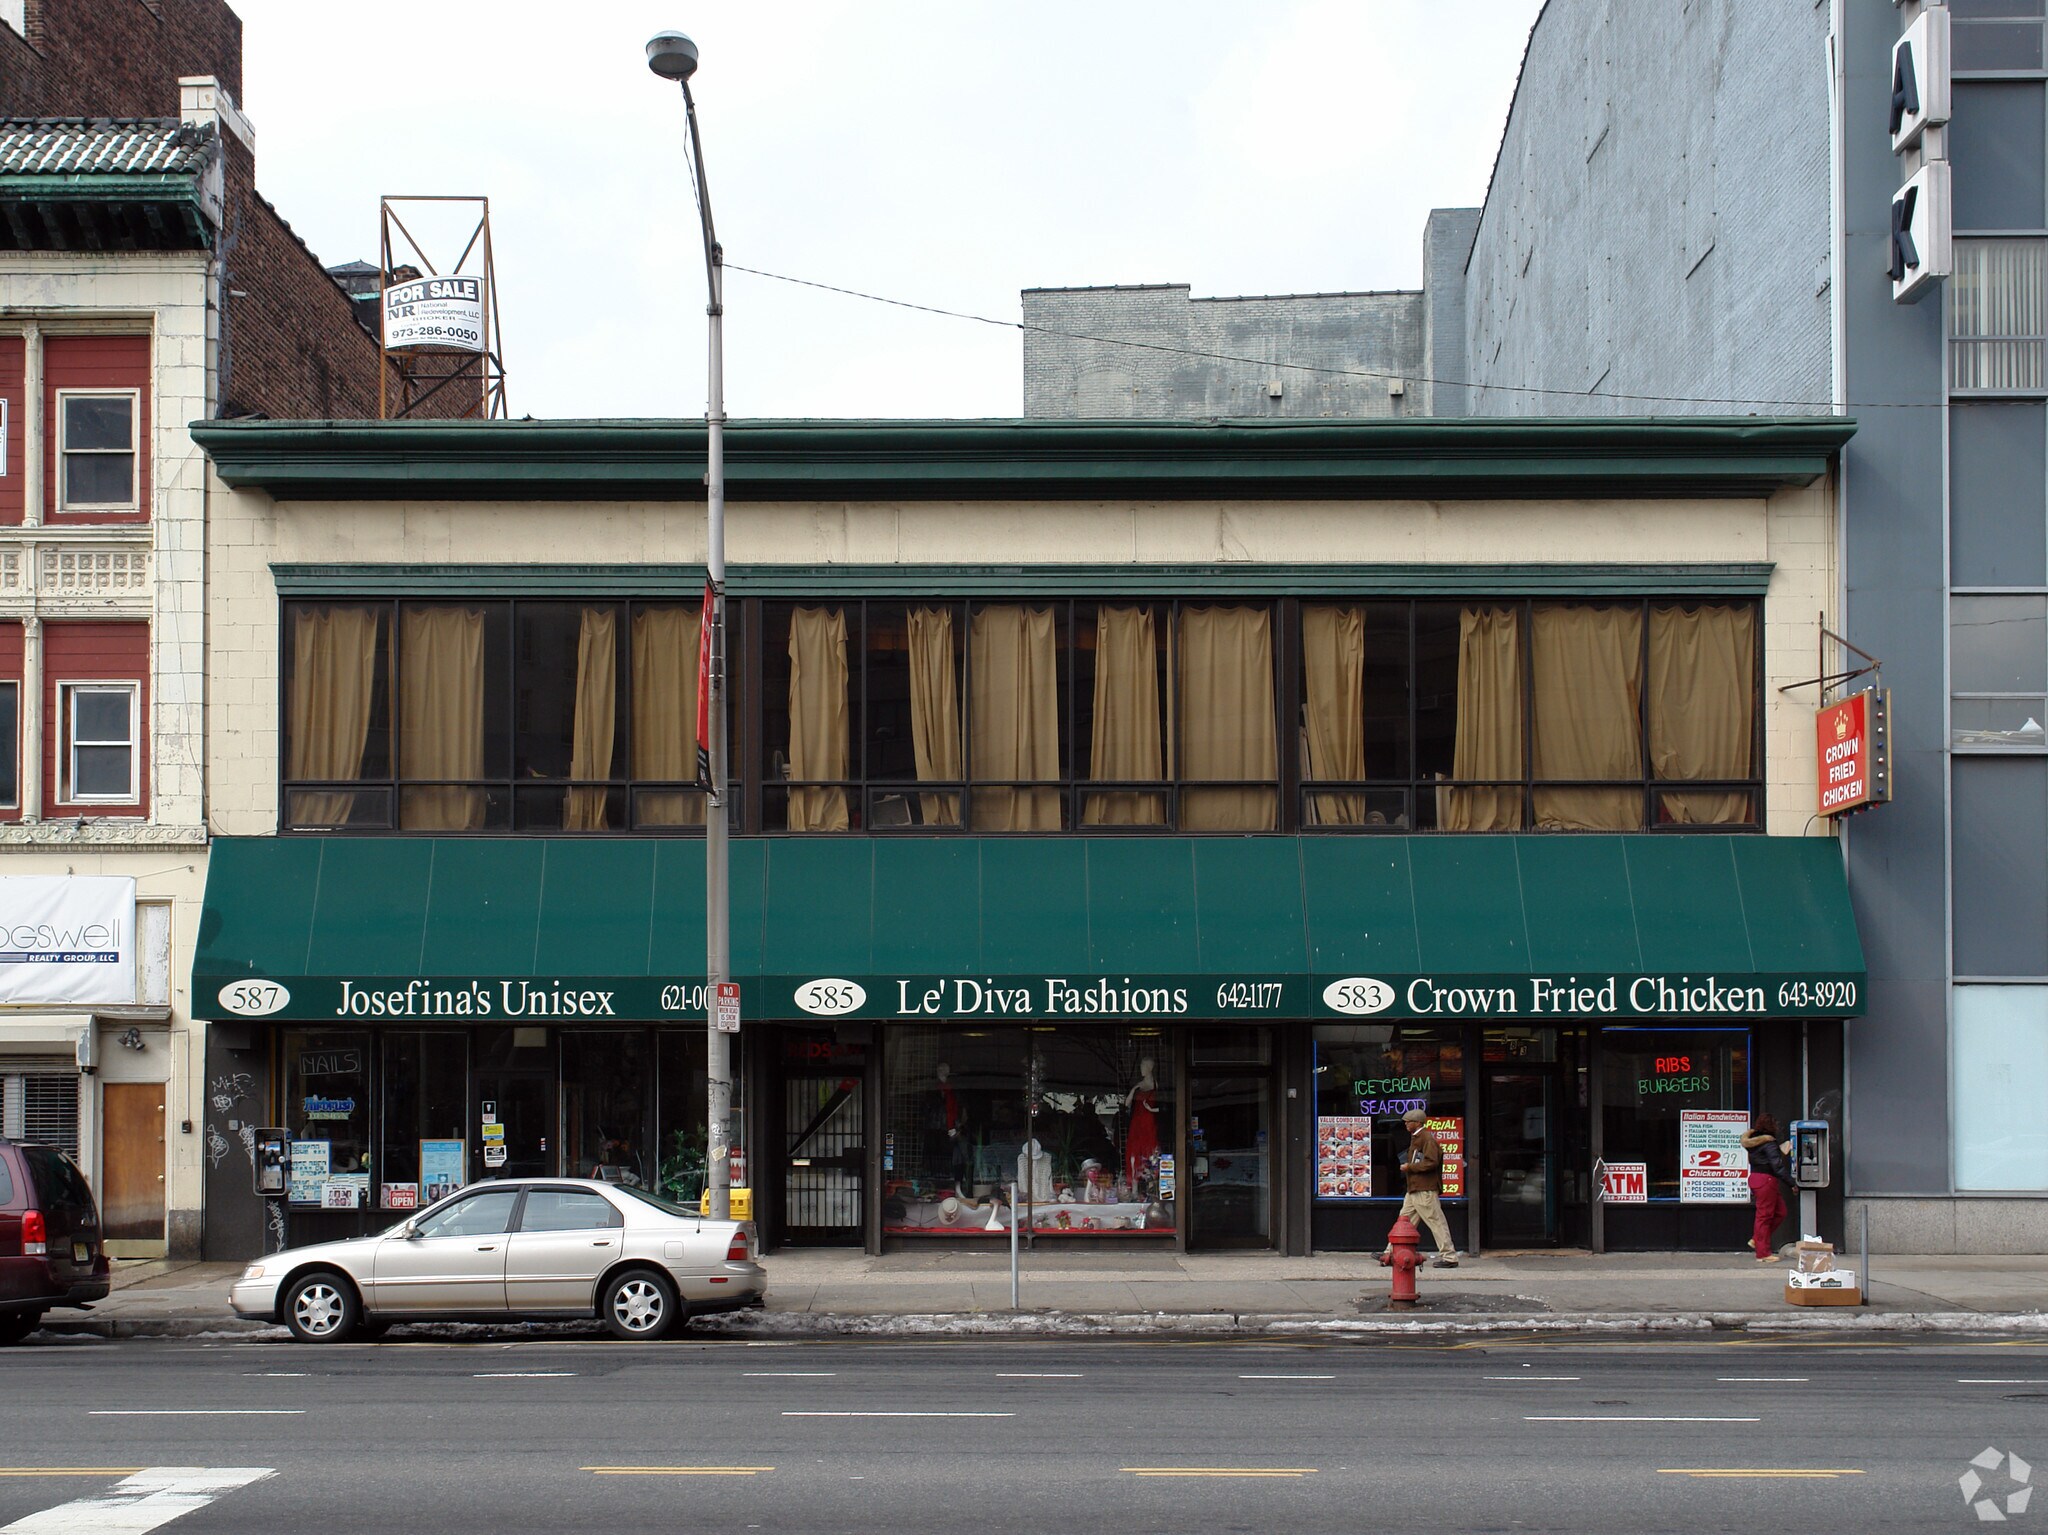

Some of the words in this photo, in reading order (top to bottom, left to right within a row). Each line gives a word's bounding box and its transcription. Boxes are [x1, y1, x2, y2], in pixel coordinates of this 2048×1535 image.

[390, 285, 424, 306] FOR
[430, 280, 476, 299] SALE
[388, 305, 415, 320] NR
[469, 311, 480, 319] LLC
[392, 326, 478, 341] 973-286-0050
[1825, 737, 1859, 764] CROWN
[1829, 759, 1856, 784] FRIED
[1823, 779, 1863, 807] CHICKEN
[29, 954, 60, 962] REALTY
[63, 954, 96, 963] GROUP,
[99, 954, 115, 962] LLC
[232, 987, 278, 1010] 587
[335, 980, 491, 1016] Josefina's
[500, 980, 616, 1016] Unisex
[723, 986, 733, 996] NO
[808, 986, 853, 1009] 585
[896, 978, 946, 1015] Le'
[953, 978, 1033, 1014] Diva
[1045, 978, 1188, 1014] Fashions
[1216, 982, 1283, 1009] 642-1177
[1336, 985, 1382, 1009] 583
[1406, 977, 1518, 1014] Crown
[1530, 976, 1618, 1013] Fried
[1629, 976, 1767, 1013] Chicken
[1778, 981, 1857, 1008] 643-8920
[718, 996, 739, 1006] PARKING
[302, 1053, 357, 1073] NAILS
[1655, 1056, 1691, 1073] RIBS
[1354, 1079, 1376, 1096] ICE
[1381, 1076, 1431, 1094] CREAM
[1638, 1076, 1710, 1095] BURGERS
[1360, 1099, 1427, 1115] SEAFOOD
[1707, 1113, 1747, 1121] Sandwiches
[1424, 1120, 1457, 1131] PECIAL
[1436, 1131, 1459, 1139] STEAK
[1688, 1169, 1721, 1177] Chicken
[1723, 1169, 1742, 1178] Only
[1603, 1173, 1644, 1194] ATM
[392, 1197, 414, 1206] OPEN
